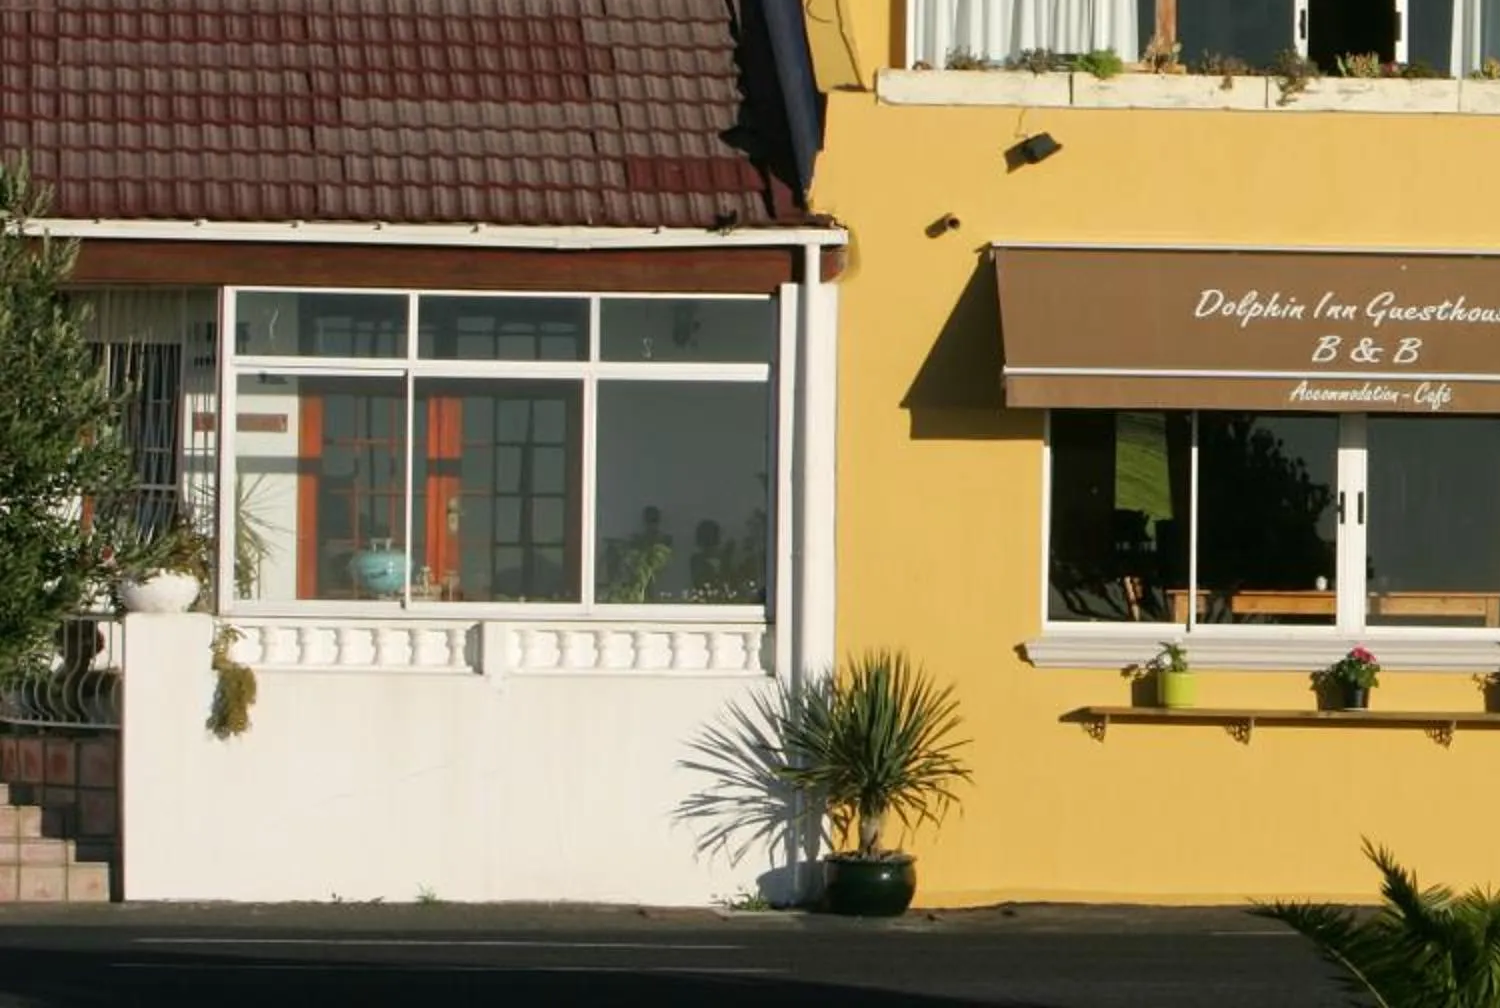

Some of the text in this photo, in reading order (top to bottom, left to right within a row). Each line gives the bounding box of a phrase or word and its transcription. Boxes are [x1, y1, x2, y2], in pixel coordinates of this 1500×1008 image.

[1194, 289, 1305, 327] Dolphin
[1313, 291, 1356, 320] Inn
[1311, 335, 1423, 364] B & B
